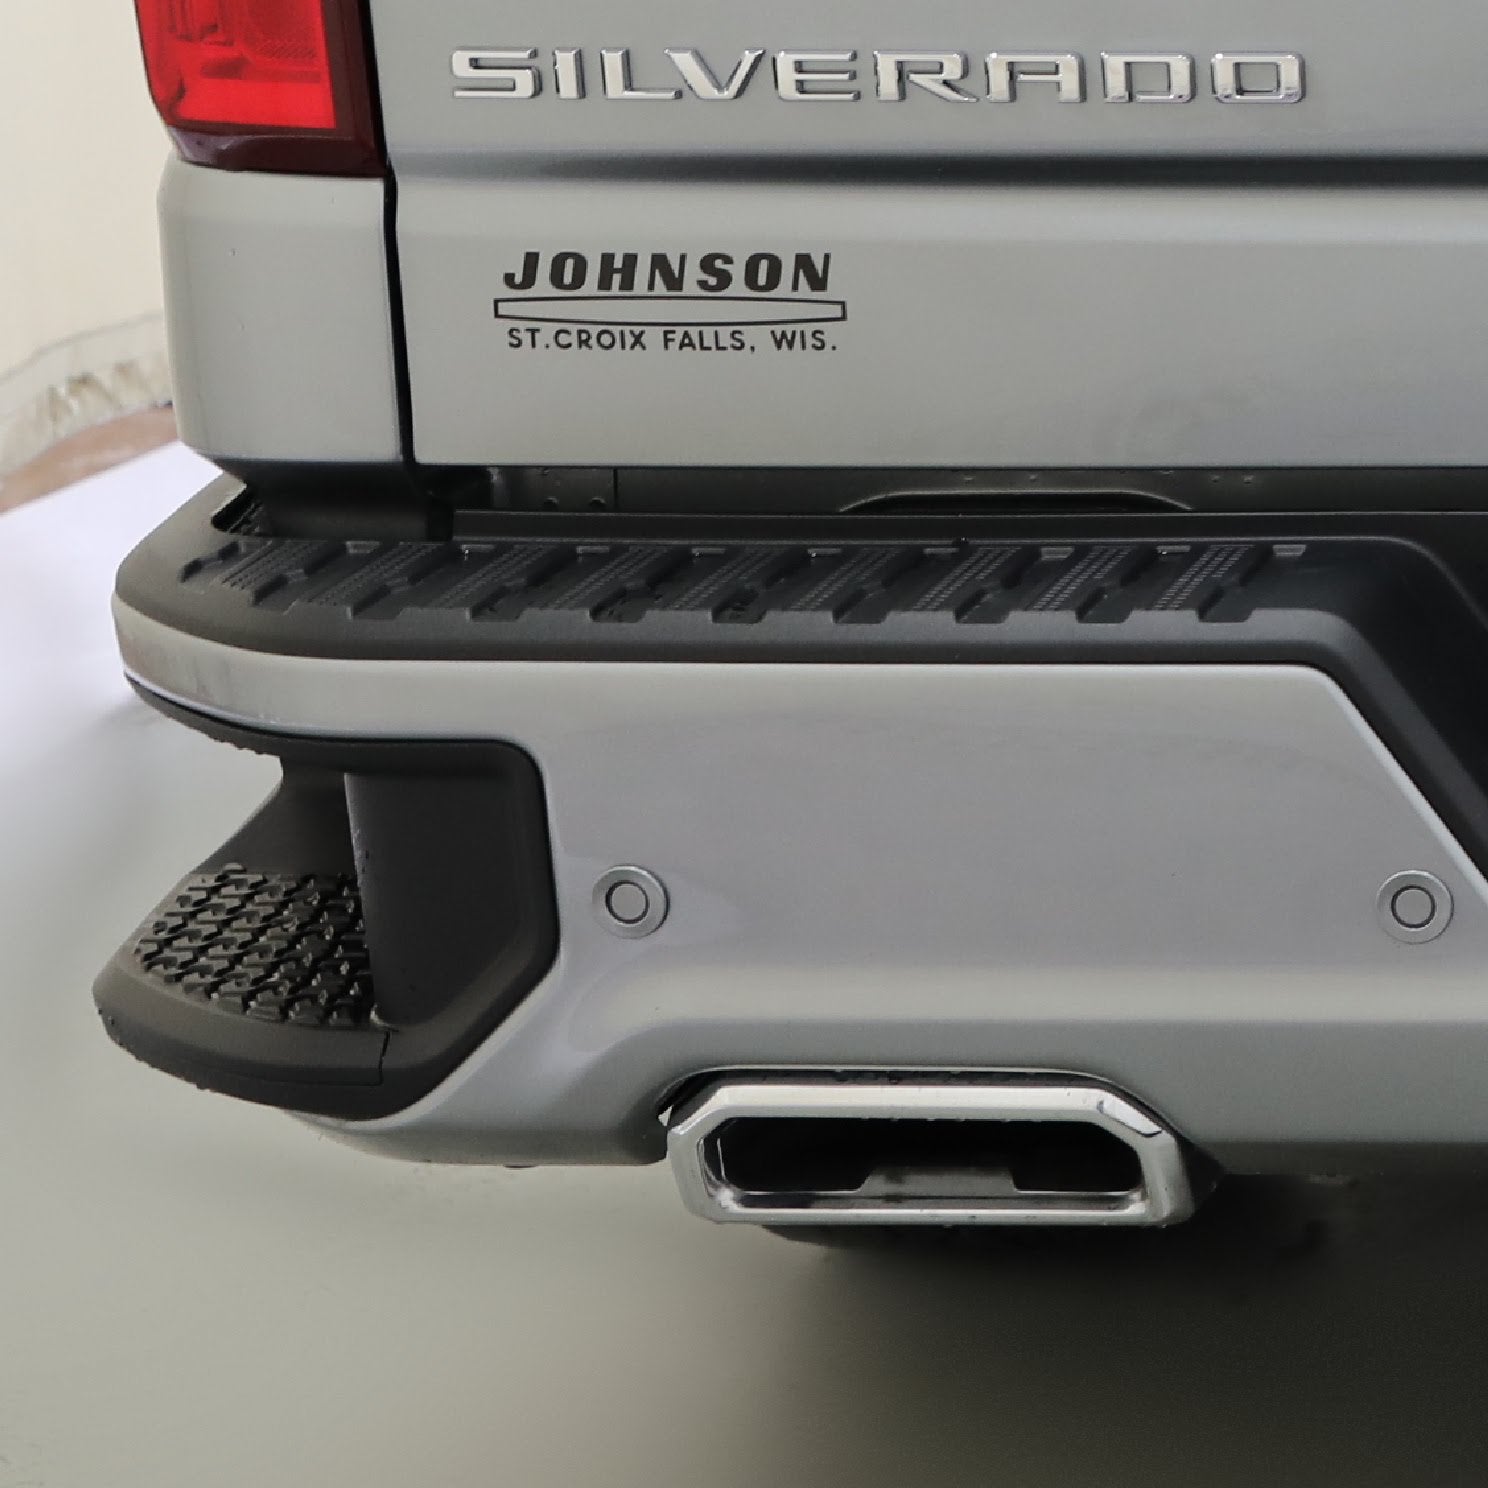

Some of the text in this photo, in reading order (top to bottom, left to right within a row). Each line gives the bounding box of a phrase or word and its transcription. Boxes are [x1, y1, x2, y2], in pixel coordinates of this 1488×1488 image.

[450, 47, 1307, 105] SILVERADO
[502, 251, 832, 292] JOHNSON
[662, 328, 756, 354] FALLS,
[770, 329, 838, 352] WIS.
